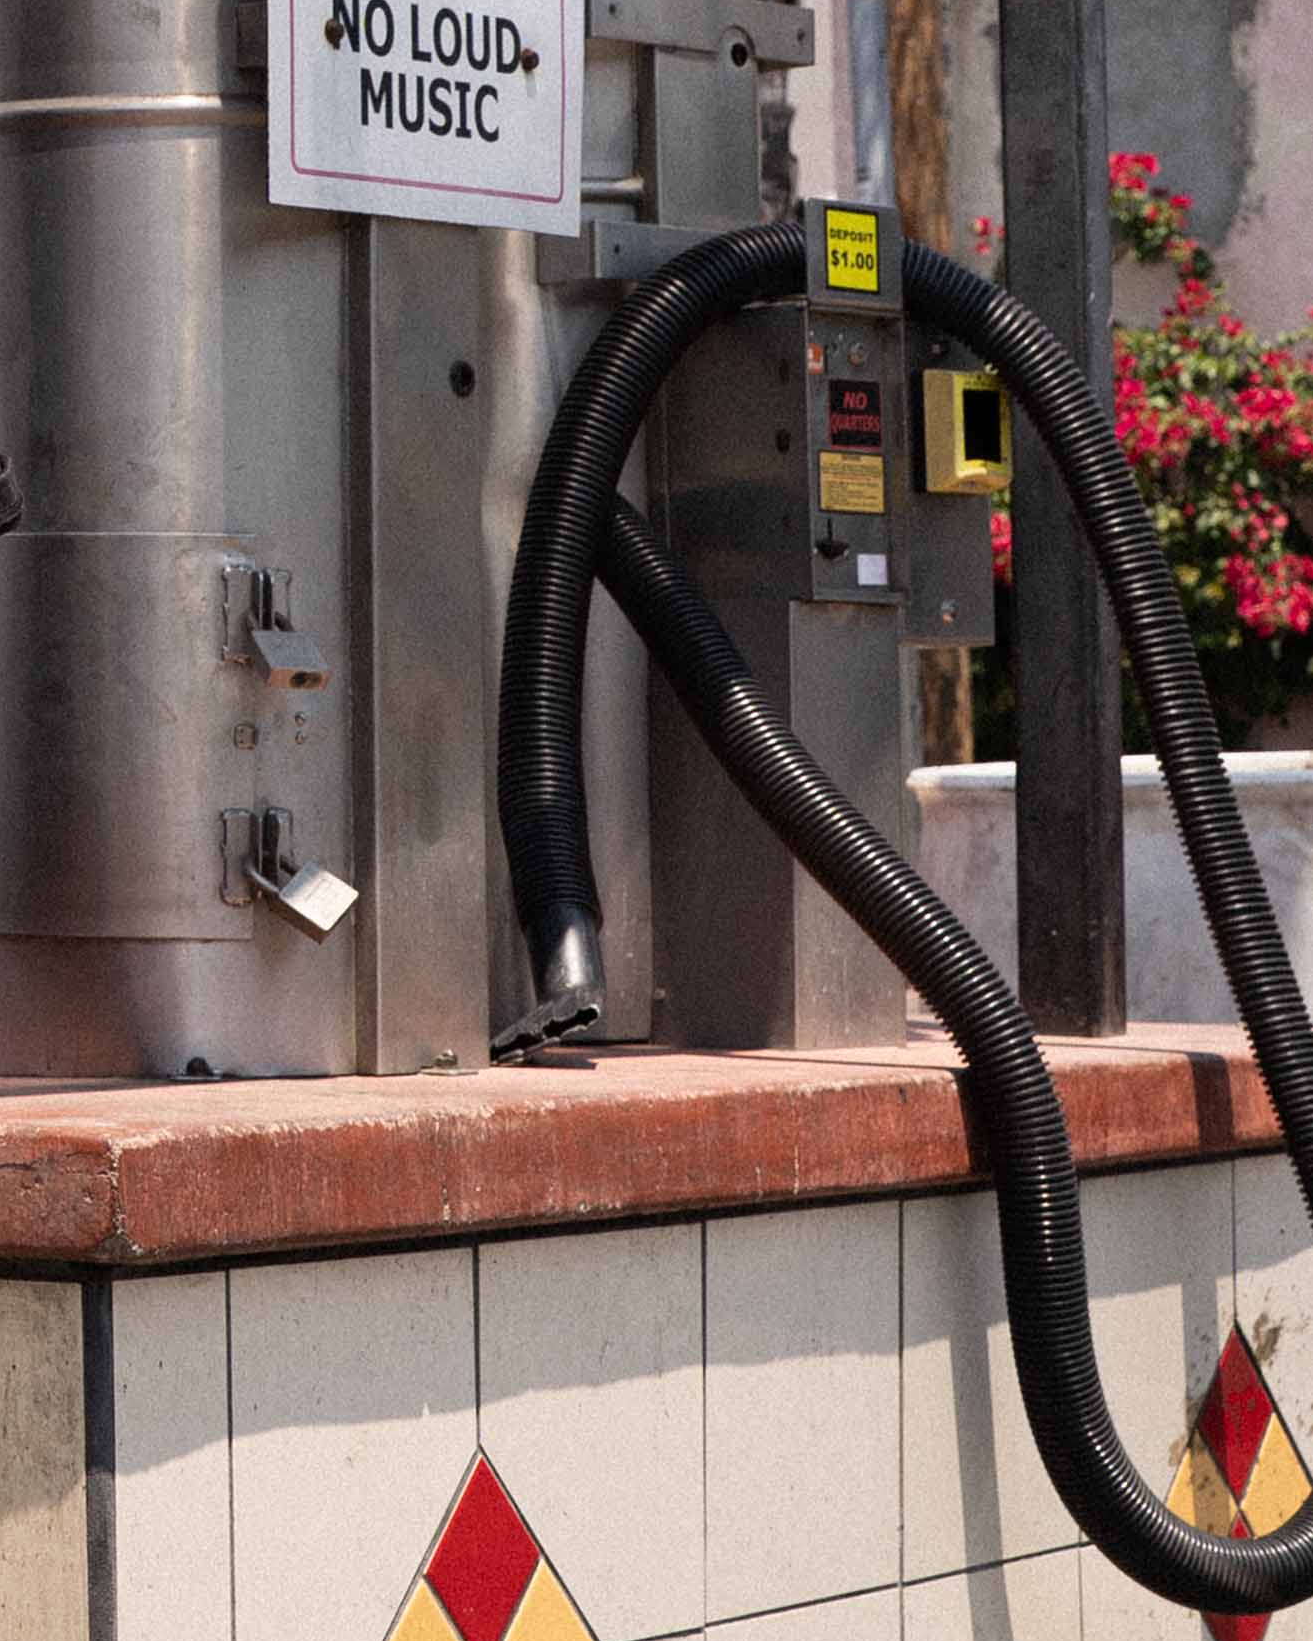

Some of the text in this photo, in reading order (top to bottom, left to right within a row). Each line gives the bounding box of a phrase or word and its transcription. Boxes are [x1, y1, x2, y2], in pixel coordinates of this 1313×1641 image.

[410, 2, 522, 75] LOUD
[360, 66, 500, 142] MUSIC
[830, 228, 873, 244] DEPOSIT
[831, 249, 874, 270] $1.00
[843, 391, 867, 409] NO
